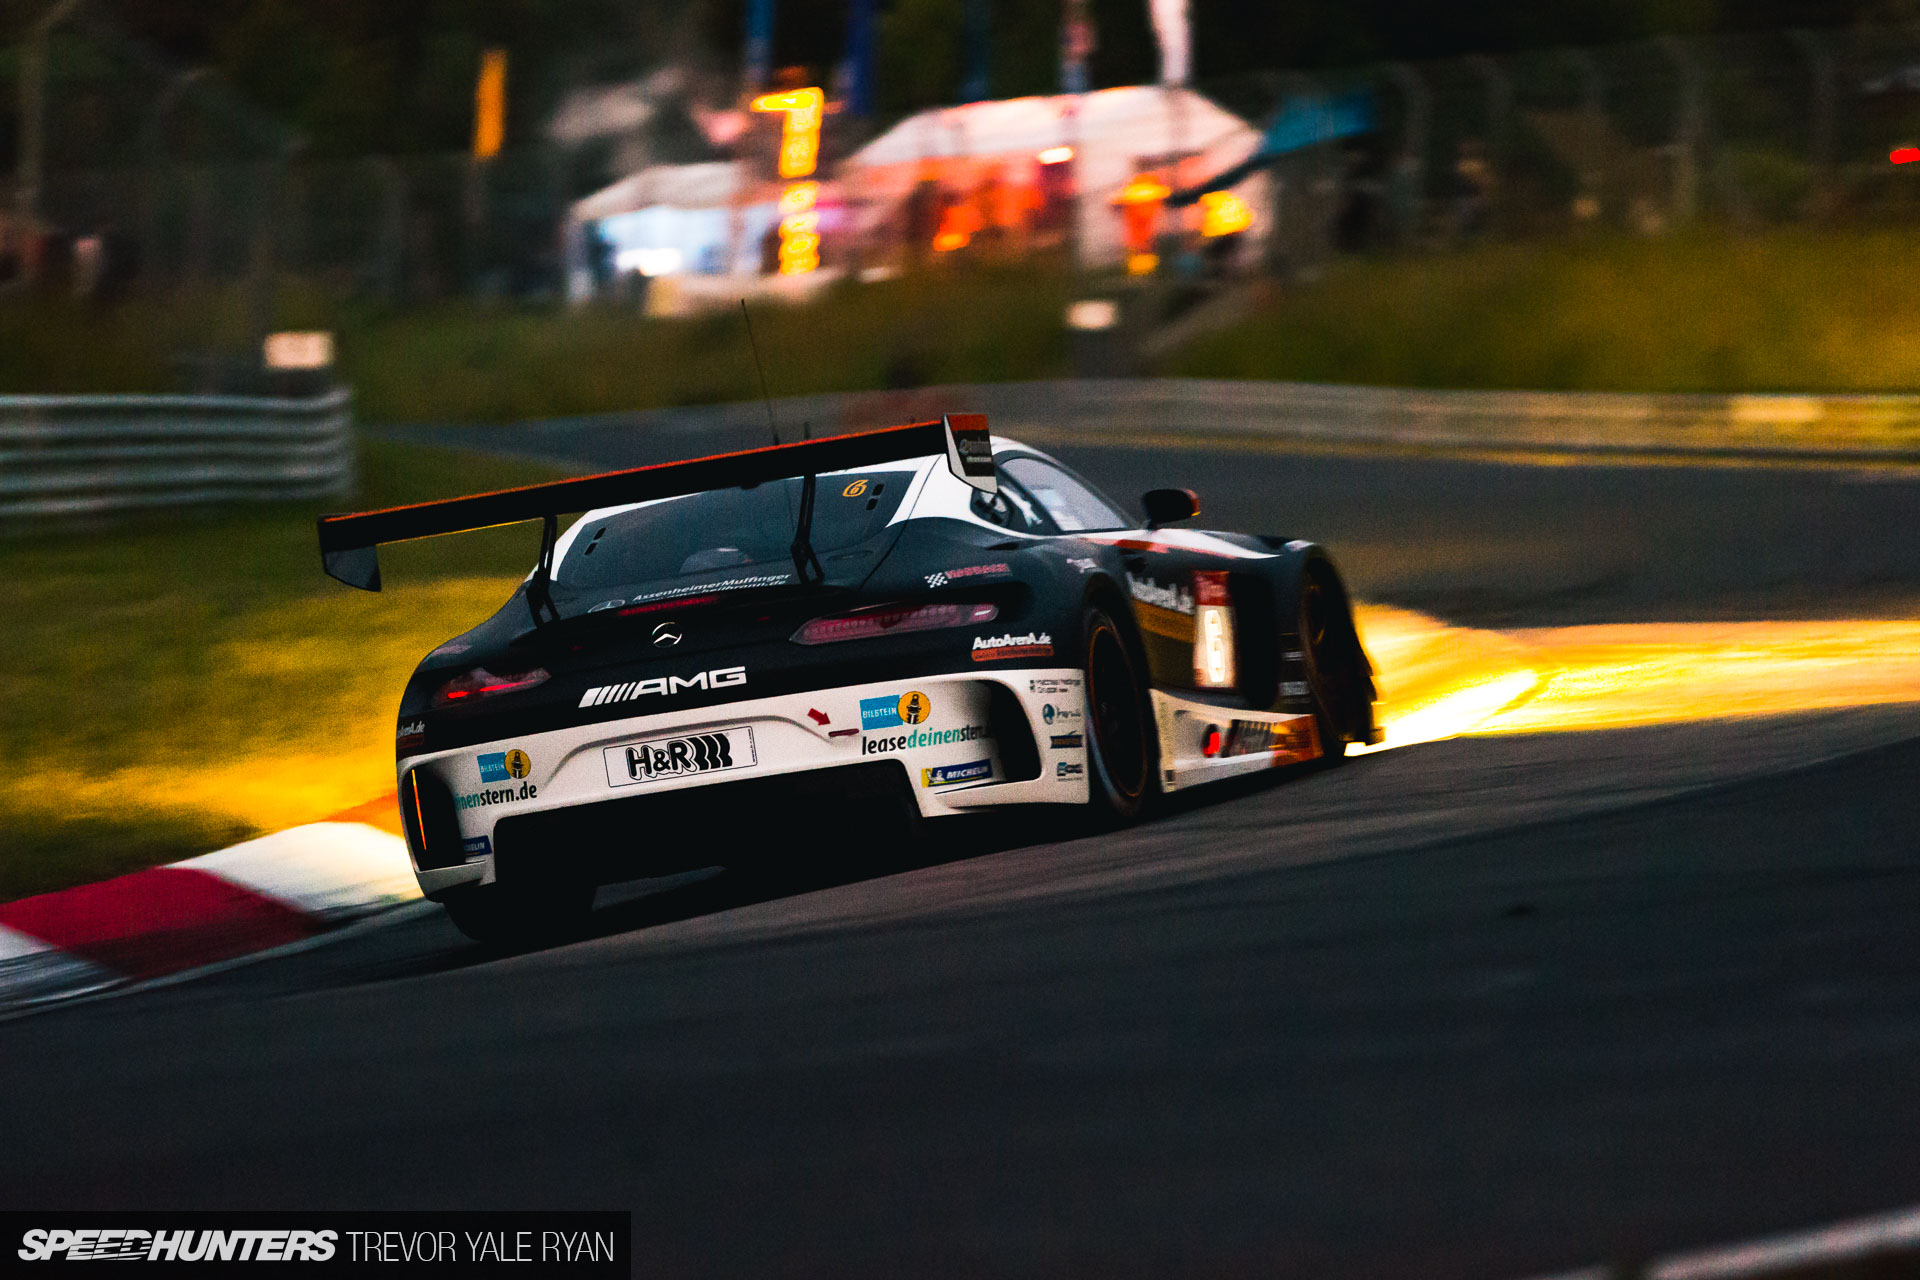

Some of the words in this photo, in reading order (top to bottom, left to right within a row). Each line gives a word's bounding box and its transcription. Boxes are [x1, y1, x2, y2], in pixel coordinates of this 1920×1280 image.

[842, 479, 869, 497] 6
[973, 632, 1052, 650] AutoArenA.de
[629, 666, 747, 700] AMG
[862, 706, 897, 719] BILSTEIN
